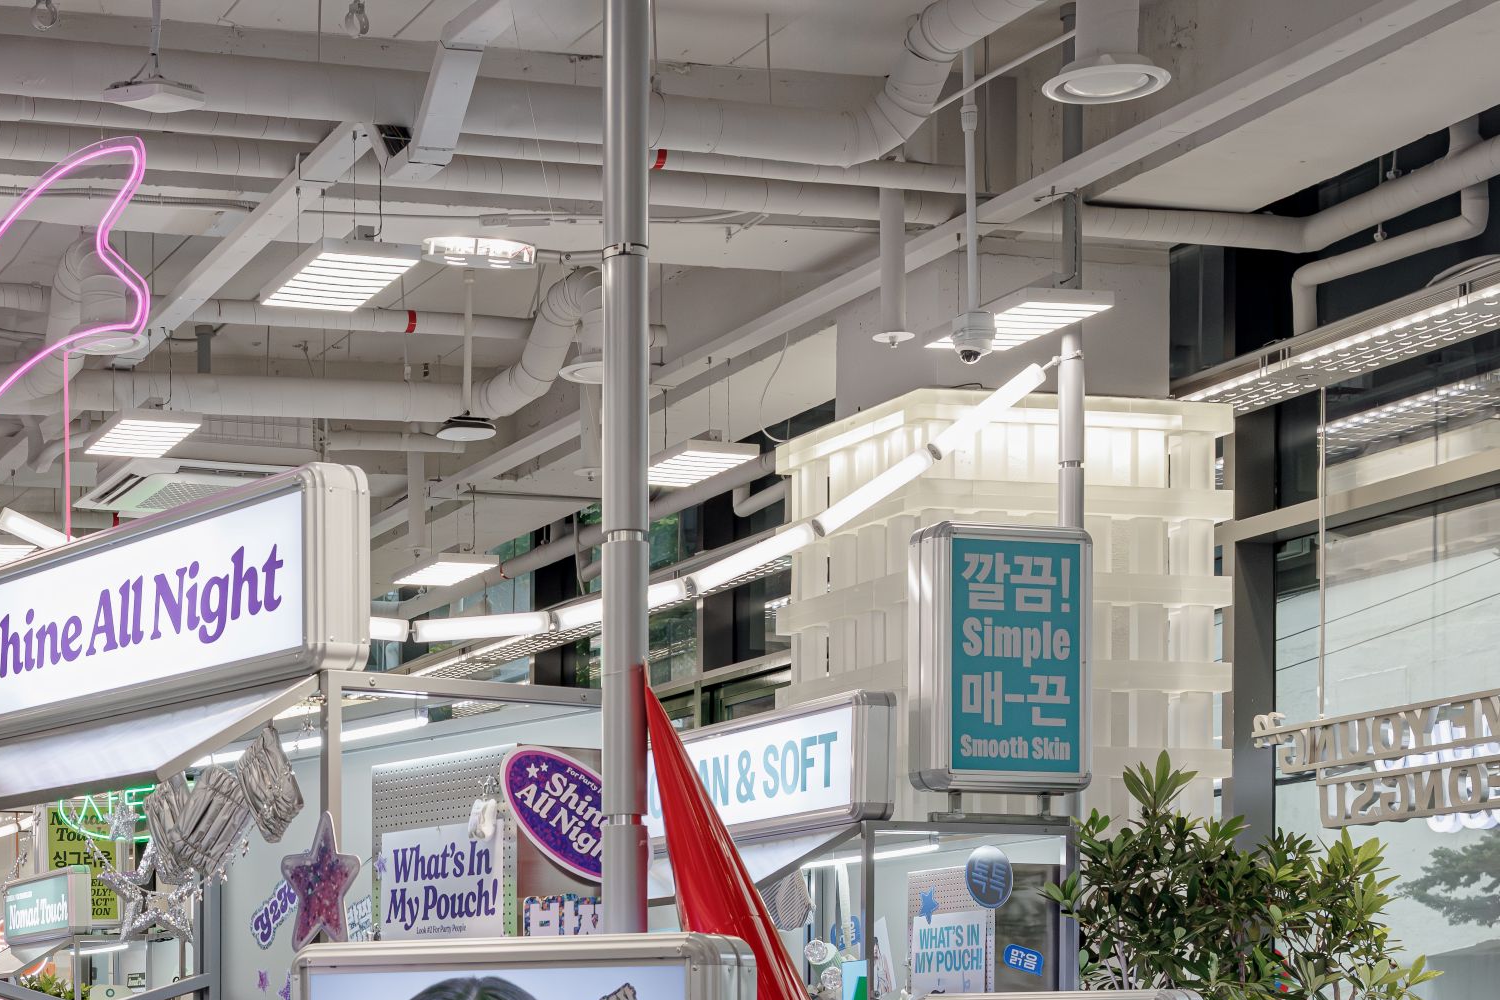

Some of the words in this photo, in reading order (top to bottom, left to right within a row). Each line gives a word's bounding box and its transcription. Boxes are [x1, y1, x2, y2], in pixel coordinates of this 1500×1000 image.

[86, 575, 145, 656] All
[150, 543, 284, 644] Night
[961, 552, 1071, 613] 깔끔!
[962, 616, 1071, 668] Simple
[961, 670, 1071, 727] 매-끈
[735, 749, 757, 804] &
[762, 730, 838, 798] SOFT
[960, 733, 1029, 760] Smooth
[1031, 736, 1071, 761] Skin
[514, 782, 556, 820] All
[549, 806, 603, 862] Nig
[545, 771, 603, 833] Shin
[392, 842, 465, 884] What's
[467, 840, 493, 876] In
[9, 898, 40, 930] Nomad
[40, 893, 68, 924] Touch
[385, 887, 420, 931] My
[421, 878, 498, 921] Pouch!
[915, 951, 934, 974] MY
[937, 946, 983, 974] POUCH!
[919, 924, 964, 950] WHAT'S
[967, 923, 980, 946] IN
